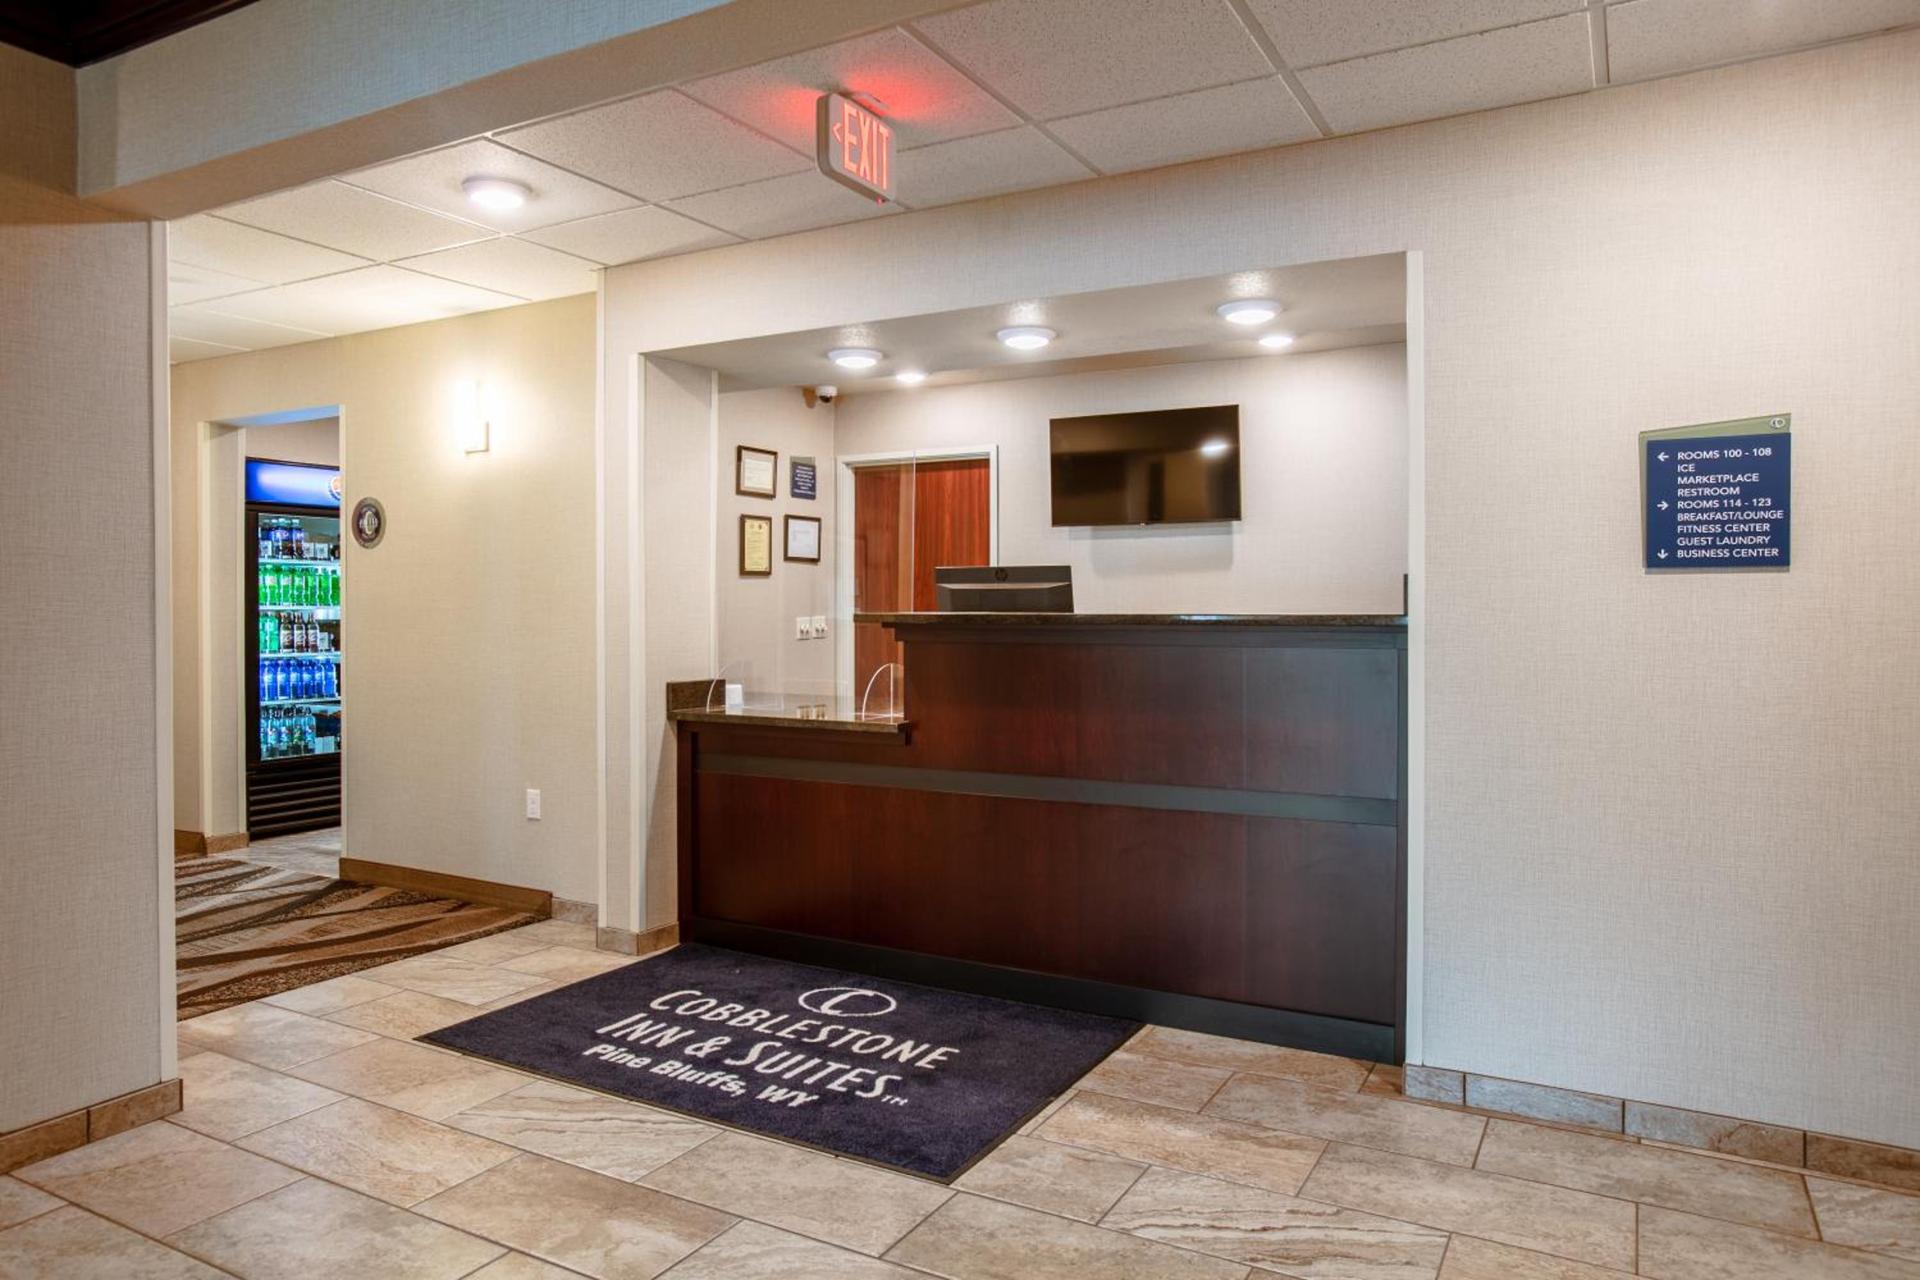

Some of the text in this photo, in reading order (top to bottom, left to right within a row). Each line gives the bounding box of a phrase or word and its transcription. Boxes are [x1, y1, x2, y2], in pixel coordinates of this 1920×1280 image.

[844, 102, 889, 190] EXIT
[1677, 450, 1720, 460] ROOMS
[1723, 449, 1742, 458] 100
[1753, 447, 1772, 456] 108
[1677, 464, 1696, 472] ICE
[1677, 473, 1760, 485] MARKETPLACE
[1677, 487, 1740, 497] RESTROOM
[1677, 500, 1720, 509] ROOMS
[1723, 499, 1742, 508] 114
[1752, 498, 1772, 507] 123
[1677, 510, 1784, 521] BREAKFAST/LOUNGE
[1677, 523, 1771, 533] FITNESS CENTER
[1677, 536, 1771, 546] GUEST LAUNDRY
[1677, 548, 1779, 558] BUSINESS CENTER
[650, 990, 960, 1069] COBBLESTONE
[596, 1013, 696, 1048] INN
[684, 1036, 731, 1058] &
[724, 1041, 903, 1098] SUITES
[582, 1044, 820, 1107] Pine Bluffs, WY
